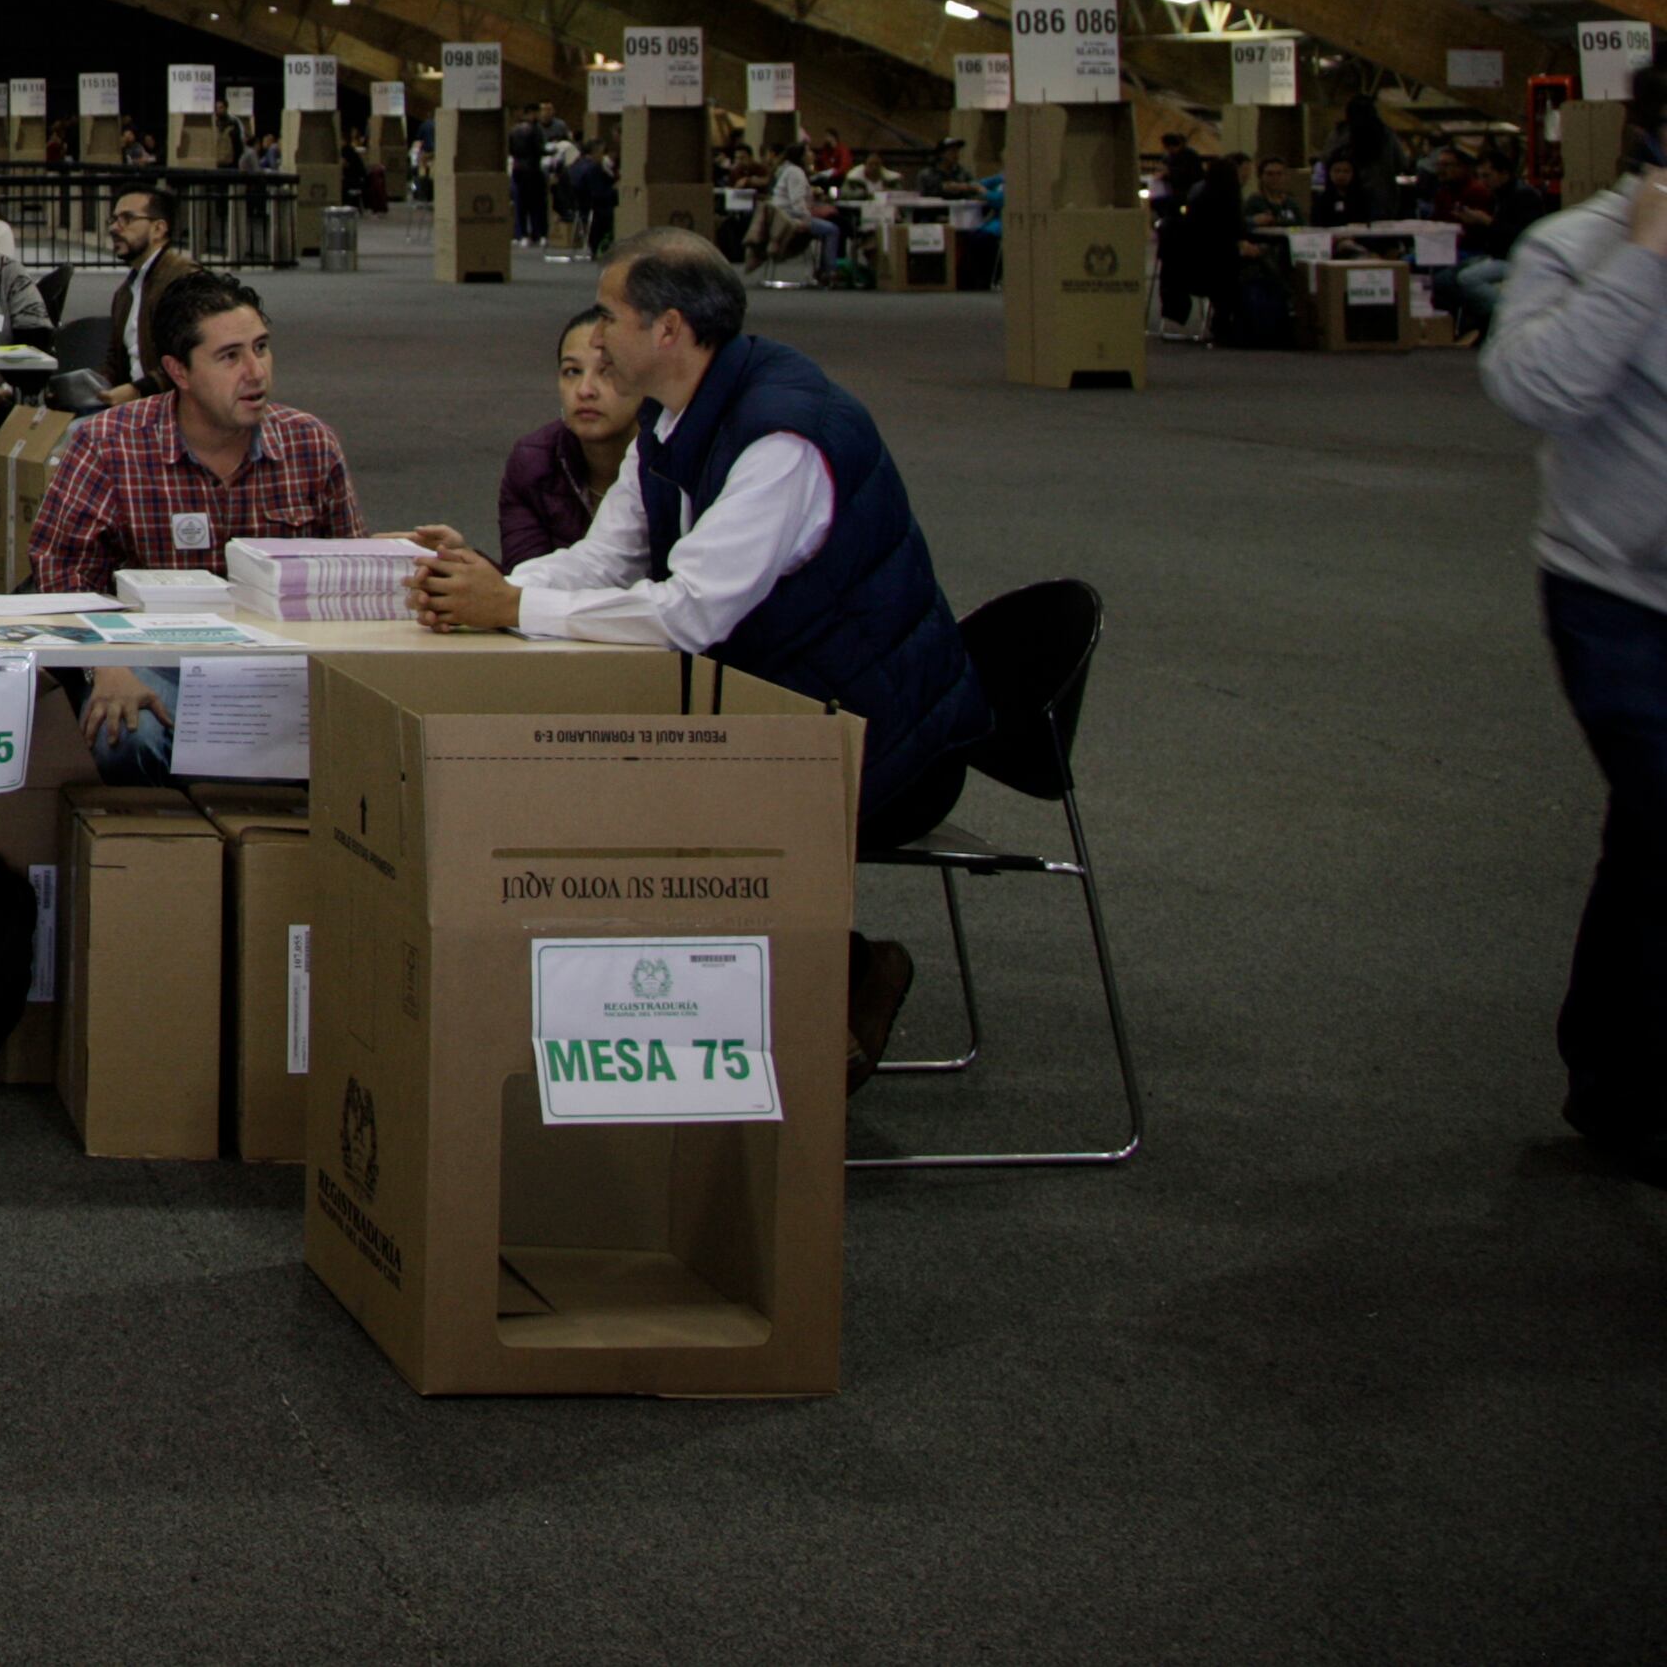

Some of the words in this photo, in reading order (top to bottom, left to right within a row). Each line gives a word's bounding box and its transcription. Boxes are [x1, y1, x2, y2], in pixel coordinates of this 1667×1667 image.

[1017, 9, 1065, 34] 086
[1076, 9, 1117, 34] 086
[626, 36, 662, 56] 095
[668, 36, 699, 55] 095
[1582, 32, 1621, 51] 096
[1627, 32, 1649, 50] 096
[445, 50, 473, 67] 098
[1235, 47, 1265, 63] 097
[287, 62, 312, 75] 105
[957, 60, 982, 74] 106
[535, 730, 553, 743] E-9
[557, 730, 635, 743] FORMULARIO
[638, 730, 653, 743] EL
[657, 730, 684, 745] AQUÍ
[689, 730, 727, 743] PEGUE
[502, 871, 555, 904] AQUÍ
[562, 876, 621, 899] VOTO
[627, 876, 654, 899] SU
[662, 876, 770, 899] DEPOSITE
[604, 1000, 698, 1011] REGISTRADURÍA
[544, 1038, 677, 1082] MESA
[692, 1038, 750, 1080] 75
[318, 1168, 402, 1272] REGISTRADURÍA
